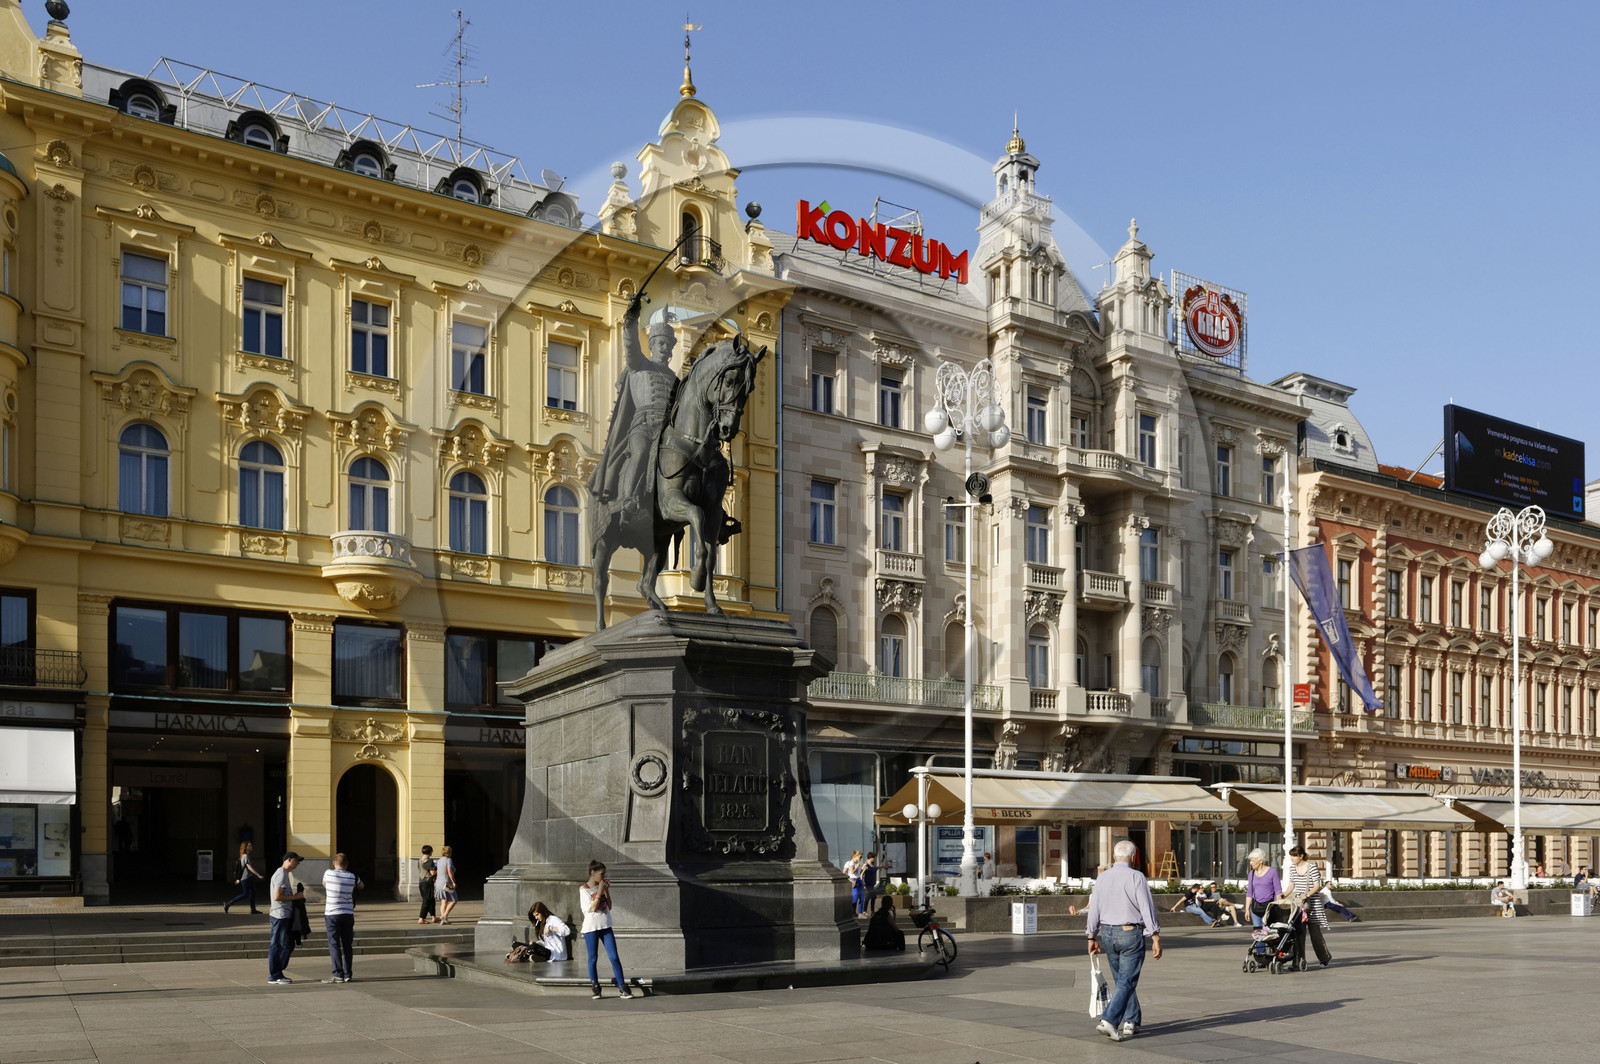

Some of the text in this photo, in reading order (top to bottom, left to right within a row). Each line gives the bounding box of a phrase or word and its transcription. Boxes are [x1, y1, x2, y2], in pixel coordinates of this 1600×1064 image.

[797, 199, 969, 285] KONZUM
[154, 713, 248, 732] HARMICA
[479, 728, 526, 744] HARM
[718, 744, 753, 765] BAN
[1408, 764, 1441, 779] Müller
[1001, 809, 1032, 818] BECK'S
